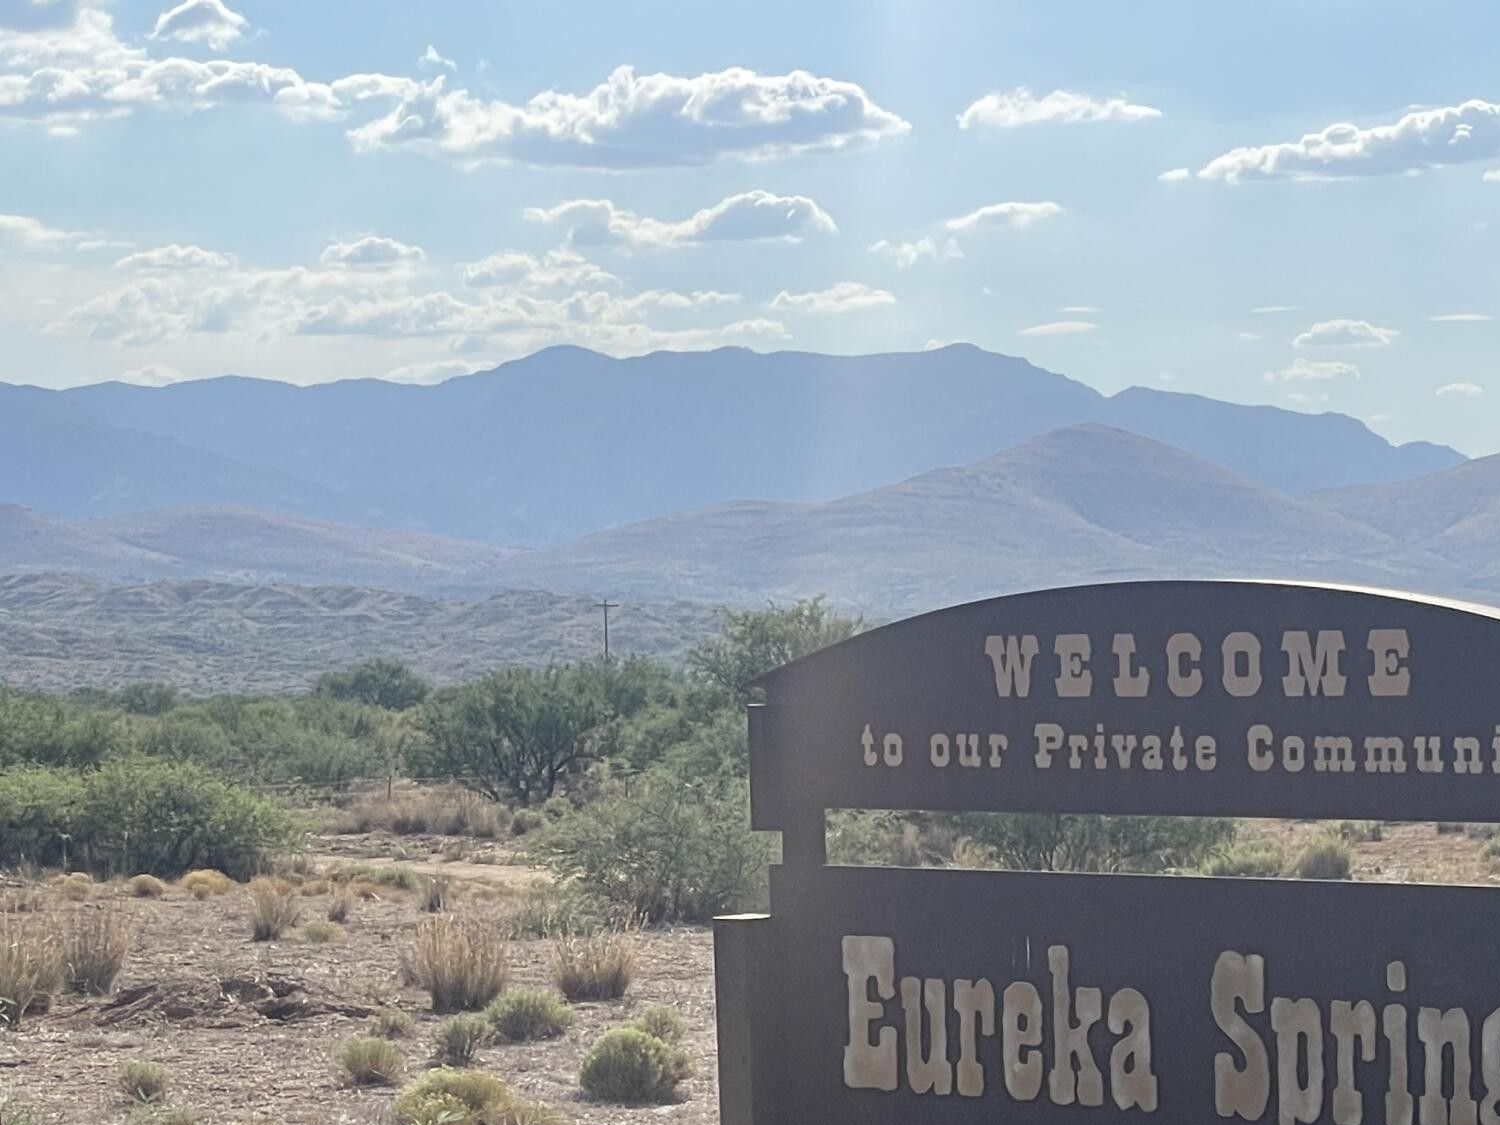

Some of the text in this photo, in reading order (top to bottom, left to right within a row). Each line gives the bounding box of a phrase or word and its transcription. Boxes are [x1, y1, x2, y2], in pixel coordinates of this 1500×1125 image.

[984, 628, 1412, 698] WELCOME
[861, 724, 903, 766] to
[929, 727, 1009, 769] our
[1033, 722, 1218, 772] Private
[841, 935, 1158, 1114] Eureka
